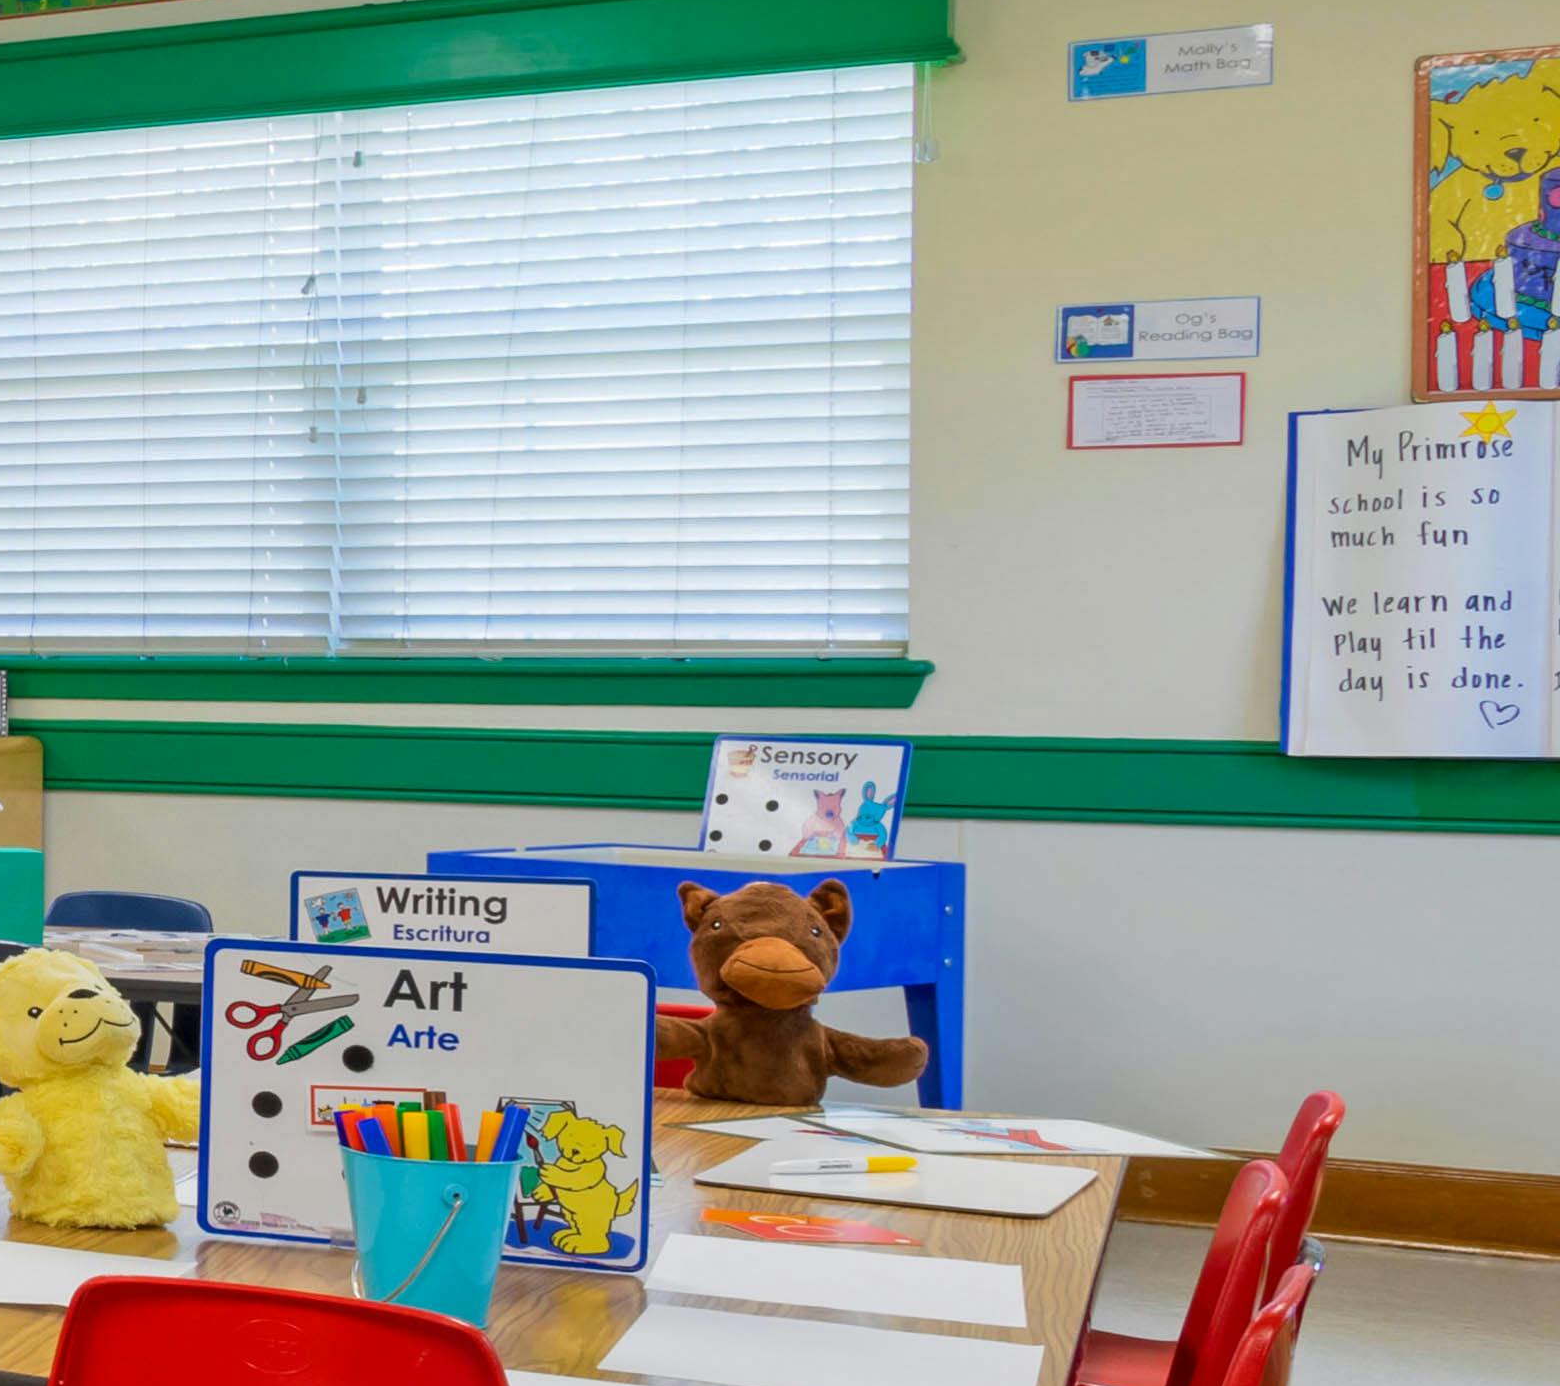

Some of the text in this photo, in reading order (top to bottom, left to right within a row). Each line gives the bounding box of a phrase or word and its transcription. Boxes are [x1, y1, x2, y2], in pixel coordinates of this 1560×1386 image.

[1178, 41, 1239, 56] Molly's
[1164, 57, 1251, 73] Math Bag
[1174, 312, 1217, 328] Og's
[1138, 325, 1254, 344] Reading Bag
[1347, 431, 1513, 479] My Primrose
[1328, 486, 1500, 515] school is so
[1331, 521, 1469, 548] much fun
[1374, 592, 1448, 614] learn
[1465, 590, 1512, 612] and
[1403, 625, 1506, 650] til the
[1339, 665, 1524, 701] day is done.
[759, 745, 859, 772] Sensory
[773, 767, 840, 783] Sensorial
[376, 886, 508, 924] Writing
[393, 924, 491, 945] Escritura
[384, 968, 468, 1013] Art
[387, 1023, 460, 1051] Arte
